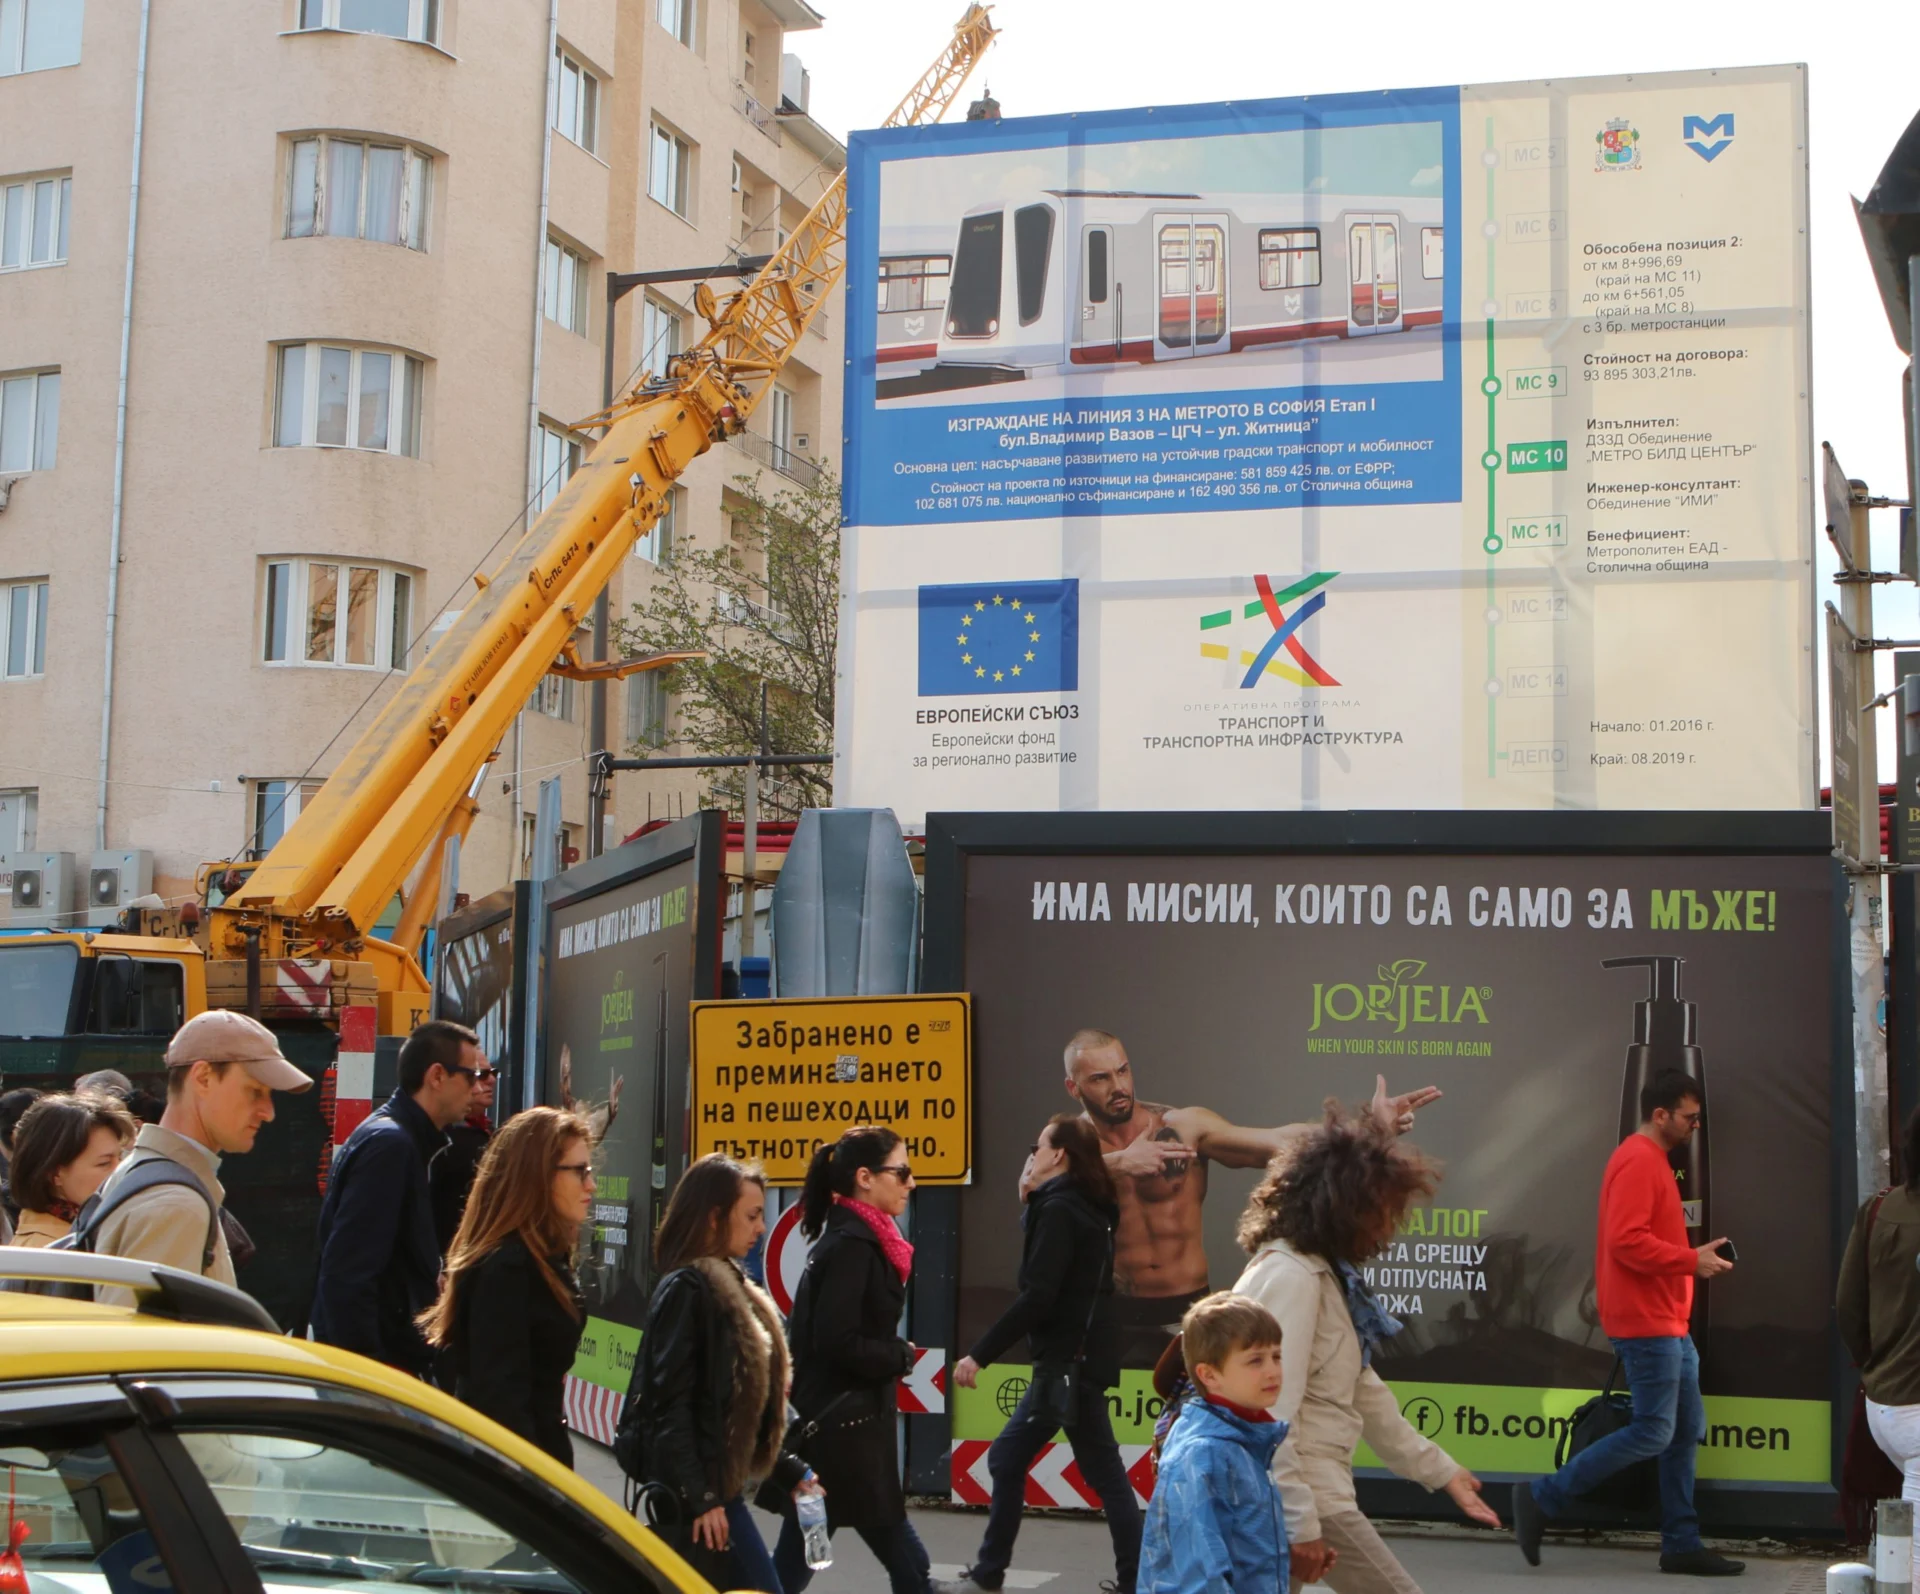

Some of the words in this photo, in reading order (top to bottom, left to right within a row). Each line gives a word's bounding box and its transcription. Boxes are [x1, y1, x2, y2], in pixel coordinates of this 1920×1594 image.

[1548, 218, 1557, 232] 6
[1583, 241, 1662, 255] Обособена
[1667, 238, 1726, 251] позиция
[1730, 236, 1743, 247] 2:
[1583, 261, 1597, 271] от
[1601, 260, 1617, 270] км
[1622, 255, 1683, 269] 8+996,69
[1595, 274, 1631, 288] (край
[1635, 274, 1650, 284] на
[1654, 271, 1677, 283] МС
[1682, 269, 1701, 283] 11)
[1582, 292, 1600, 304] до
[1603, 291, 1620, 301] км
[1624, 286, 1685, 300] 6+561,05
[1595, 305, 1631, 319] (край
[1635, 305, 1650, 315] на
[1654, 302, 1677, 314] МС
[1681, 301, 1694, 315] 8)
[1594, 322, 1602, 333] 3
[1606, 320, 1627, 334] бр.
[1631, 316, 1726, 332] метростанции
[1583, 352, 1651, 366] Стойност
[1655, 353, 1672, 363] на
[1675, 349, 1749, 363] договора:
[1516, 375, 1542, 390] МС
[1548, 374, 1557, 389] 9
[1583, 370, 1600, 381] 93
[1603, 368, 1628, 380] 895
[1632, 366, 1697, 380] 303,21лв.
[948, 413, 1048, 433] ИЗГРАЖДАНЕ
[1052, 412, 1073, 425] НА
[1077, 409, 1132, 425] ЛИНИЯ
[1136, 409, 1144, 422] 3
[1149, 408, 1170, 422] НА
[1175, 404, 1249, 420] МЕТРОТО
[1254, 403, 1264, 416] В
[1268, 399, 1326, 415] СОФИЯ
[1330, 399, 1366, 413] Етап
[1586, 416, 1680, 430] Изпълнител:
[1000, 429, 1105, 449] бул.Владимир
[1109, 429, 1154, 442] Вазов
[1171, 424, 1201, 441] ЦГЧ
[1218, 426, 1240, 440] ул.
[1585, 433, 1624, 448] ДЗЗД
[1627, 431, 1712, 445] Обединение
[894, 461, 948, 475] Основна
[951, 459, 978, 473] цел:
[981, 455, 1062, 471] насърчаване
[1065, 453, 1138, 467] развитието
[1142, 452, 1157, 463] на
[1161, 447, 1220, 463] устойчив
[1223, 445, 1273, 461] градски
[1277, 442, 1345, 457] транспорт
[1348, 443, 1356, 453] и
[1360, 438, 1433, 453] мобилност
[1512, 450, 1538, 465] МС
[1544, 448, 1563, 463] 10
[1647, 447, 1687, 461] БИЛД
[931, 481, 985, 495] Стойност
[988, 481, 1001, 491] на
[1005, 478, 1050, 493] проекта
[1053, 478, 1066, 488] по
[1069, 474, 1132, 487] източници
[1135, 474, 1149, 484] на
[1152, 470, 1237, 486] финансиране:
[1240, 468, 1262, 480] 581
[1265, 466, 1288, 479] 859
[1290, 465, 1312, 477] 425
[1315, 464, 1334, 476] лв.
[1337, 464, 1352, 475] от
[1355, 462, 1395, 476] ЕФРР;
[1586, 479, 1742, 495] Инженер-консултант:
[915, 498, 935, 510] 102
[937, 497, 958, 509] 681
[961, 496, 983, 508] 075
[985, 496, 1003, 507] лв.
[1006, 491, 1075, 506] национално
[1078, 487, 1175, 503] съфинансиране
[1178, 487, 1186, 497] и
[1189, 485, 1211, 497] 162
[1214, 484, 1236, 496] 490
[1239, 483, 1261, 495] 356
[1264, 483, 1281, 494] лв.
[1285, 482, 1298, 493] от
[1300, 479, 1361, 492] Столична
[1364, 478, 1413, 492] община
[1586, 497, 1671, 511] Обединение
[1512, 524, 1538, 539] МС
[1544, 523, 1561, 538] 11
[1587, 528, 1690, 542] Бенефициент:
[561, 542, 579, 567] 6474
[1587, 544, 1685, 559] Метрополитен
[1689, 542, 1720, 556] ЕАД
[1586, 560, 1652, 574] Столична
[1656, 559, 1709, 573] община
[1512, 599, 1538, 614] МС
[1545, 597, 1564, 612] 12
[1512, 674, 1539, 688] МС
[1545, 673, 1564, 687] 14
[916, 705, 1025, 724] ЕВРОПЕЙСКИ
[1029, 704, 1079, 721] СЪЮЗ
[1184, 702, 1278, 712] ОПЕРАТИВНА
[1283, 700, 1361, 709] ПРОГРАМА
[1218, 715, 1309, 730] ТРАНСПОРТ
[1314, 715, 1325, 727] И
[1590, 720, 1645, 733] Начало:
[1649, 719, 1703, 732] 01.2016
[932, 731, 1013, 750] Европейски
[1018, 730, 1055, 747] фонд
[1143, 734, 1254, 749] ТРАНСПОРТНА
[1258, 731, 1404, 746] ИНФРАСТРУКТУРА
[913, 756, 928, 767] за
[931, 753, 1011, 769] регионално
[1015, 751, 1077, 767] развитие
[1512, 749, 1564, 766] ДЕПО
[1590, 753, 1627, 767] Край:
[1631, 752, 1685, 764] 08.2019
[1031, 881, 1111, 921] ИМА
[1127, 883, 1260, 928] МИСИИ,
[1275, 884, 1391, 925] КОИТО
[1406, 885, 1452, 926] СА
[1469, 886, 1572, 928] САМО
[1587, 887, 1634, 929] ЗА
[1651, 889, 1776, 932] МЪЖЕ!
[736, 1020, 893, 1055] Забранено
[906, 1022, 920, 1044] е
[1307, 1038, 1341, 1053] WHEN
[1344, 1038, 1374, 1054] YOUR
[1377, 1039, 1404, 1055] SKIN
[1407, 1040, 1418, 1055] IS
[1421, 1041, 1453, 1056] BORN
[1456, 1041, 1492, 1057] AGAIN
[716, 1060, 942, 1093] преминаането
[703, 1102, 735, 1123] на
[748, 1098, 909, 1125] пешеходци
[923, 1098, 956, 1119] по
[1415, 1243, 1488, 1266] СРЕЩУ
[1380, 1268, 1487, 1291] ОТПУСНАТА
